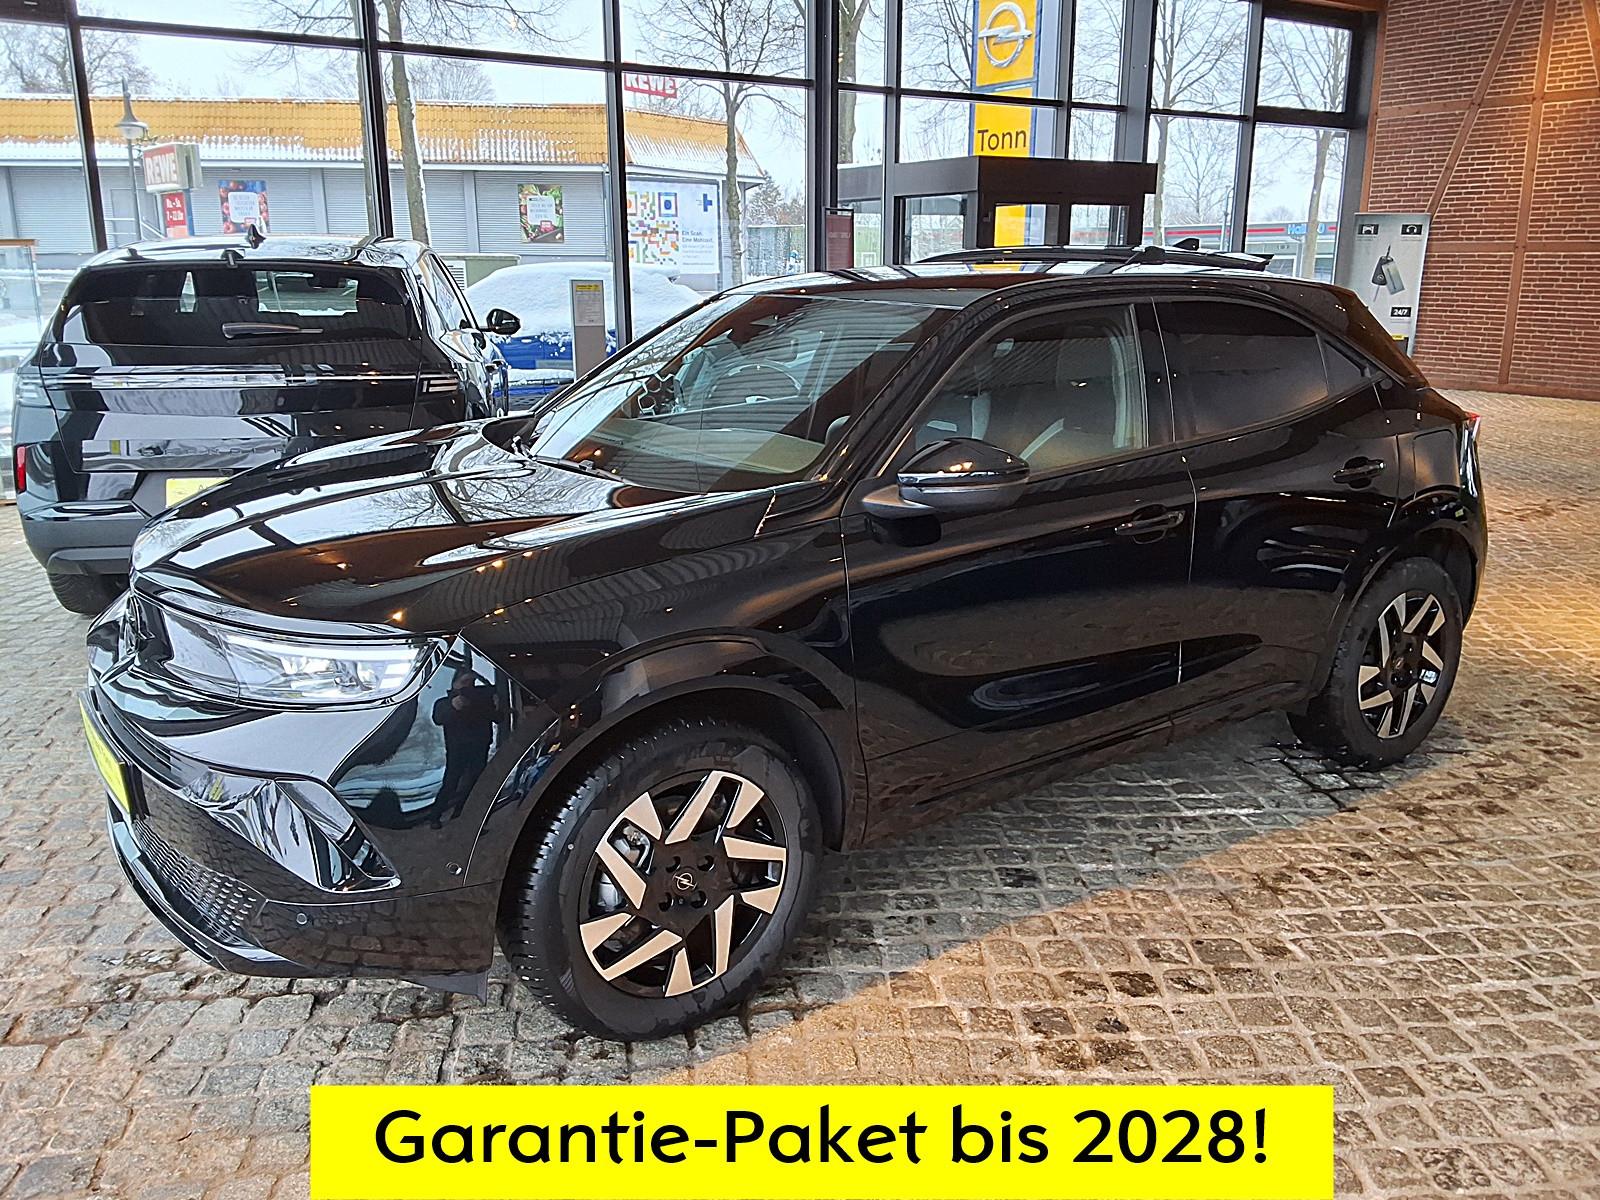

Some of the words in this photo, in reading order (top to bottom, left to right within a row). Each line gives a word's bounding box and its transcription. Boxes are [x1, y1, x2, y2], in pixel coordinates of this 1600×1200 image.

[626, 73, 675, 94] REWE
[977, 129, 1027, 151] Tonn
[145, 153, 177, 185] REWE
[1393, 308, 1408, 316] 24/7
